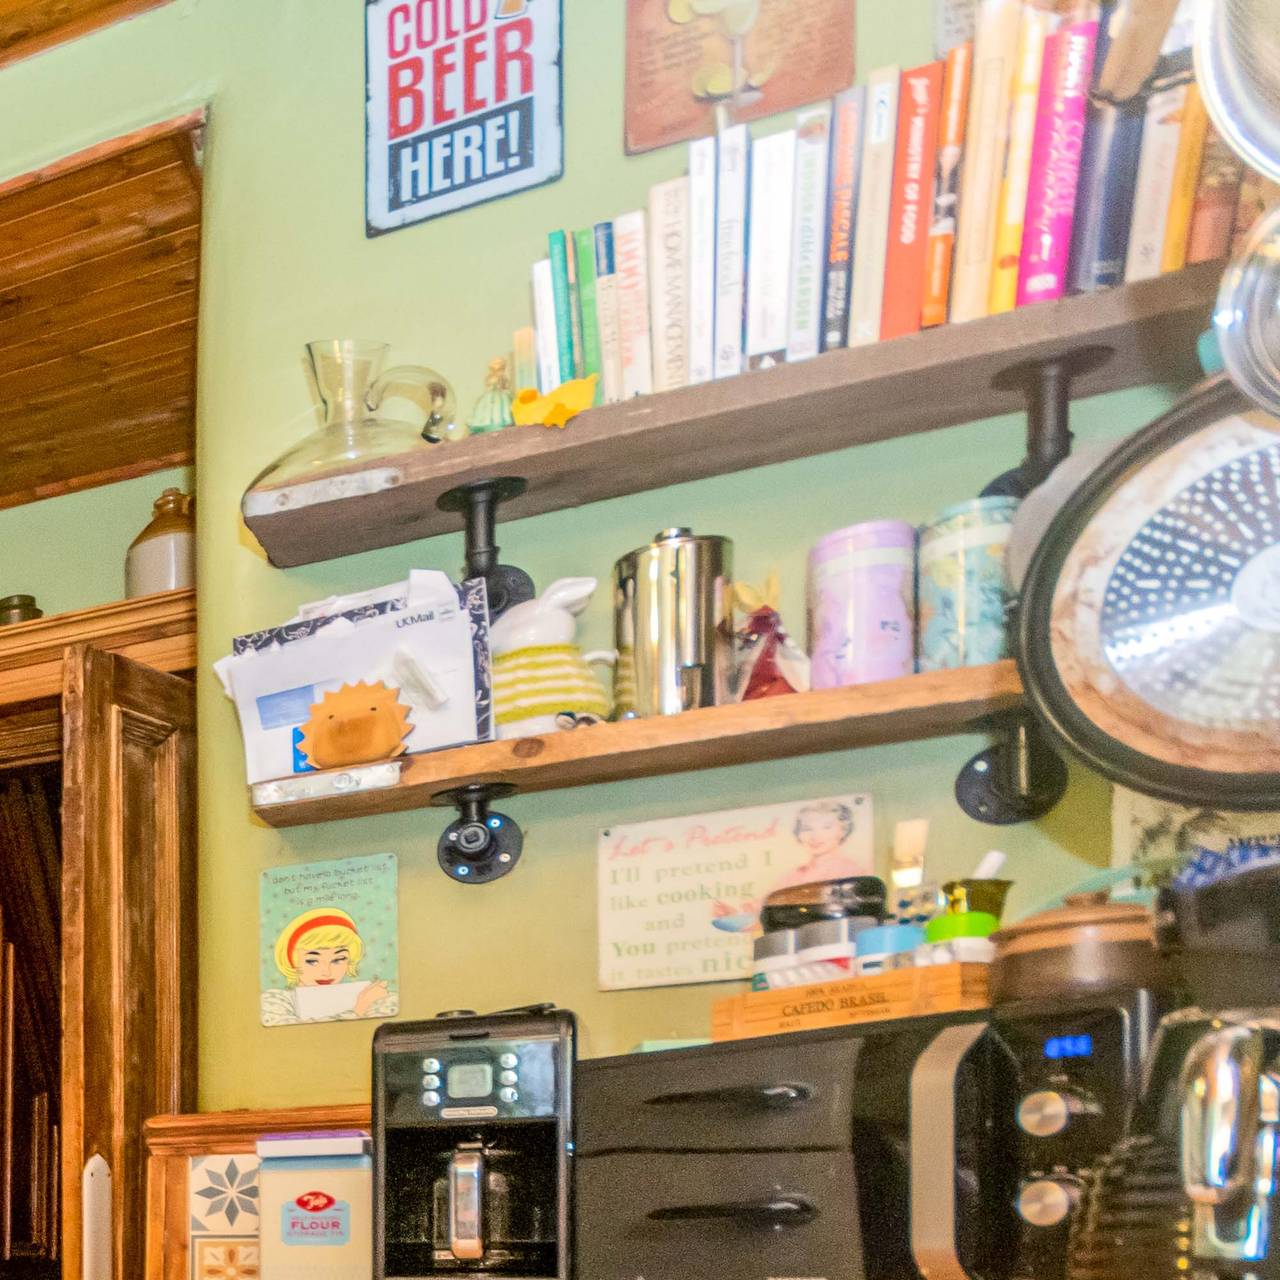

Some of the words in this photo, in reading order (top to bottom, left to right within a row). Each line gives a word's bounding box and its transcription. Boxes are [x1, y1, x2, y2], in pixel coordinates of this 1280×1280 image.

[387, 0, 487, 59] COLD
[387, 18, 534, 141] BEER
[399, 109, 521, 203] HERE!
[829, 189, 851, 264] PASCALE
[899, 204, 918, 244] FOOD
[795, 265, 815, 331] GARDEN
[686, 816, 781, 848] Pretend
[609, 867, 639, 885] I'll
[655, 853, 749, 883] pretend
[763, 850, 774, 867] I
[609, 895, 648, 911] like
[657, 881, 755, 906] cooking
[644, 912, 685, 931] and
[611, 942, 656, 958] You
[701, 952, 749, 974] nic
[840, 991, 889, 1010] BRASIL
[291, 1221, 340, 1230] FLOUR
